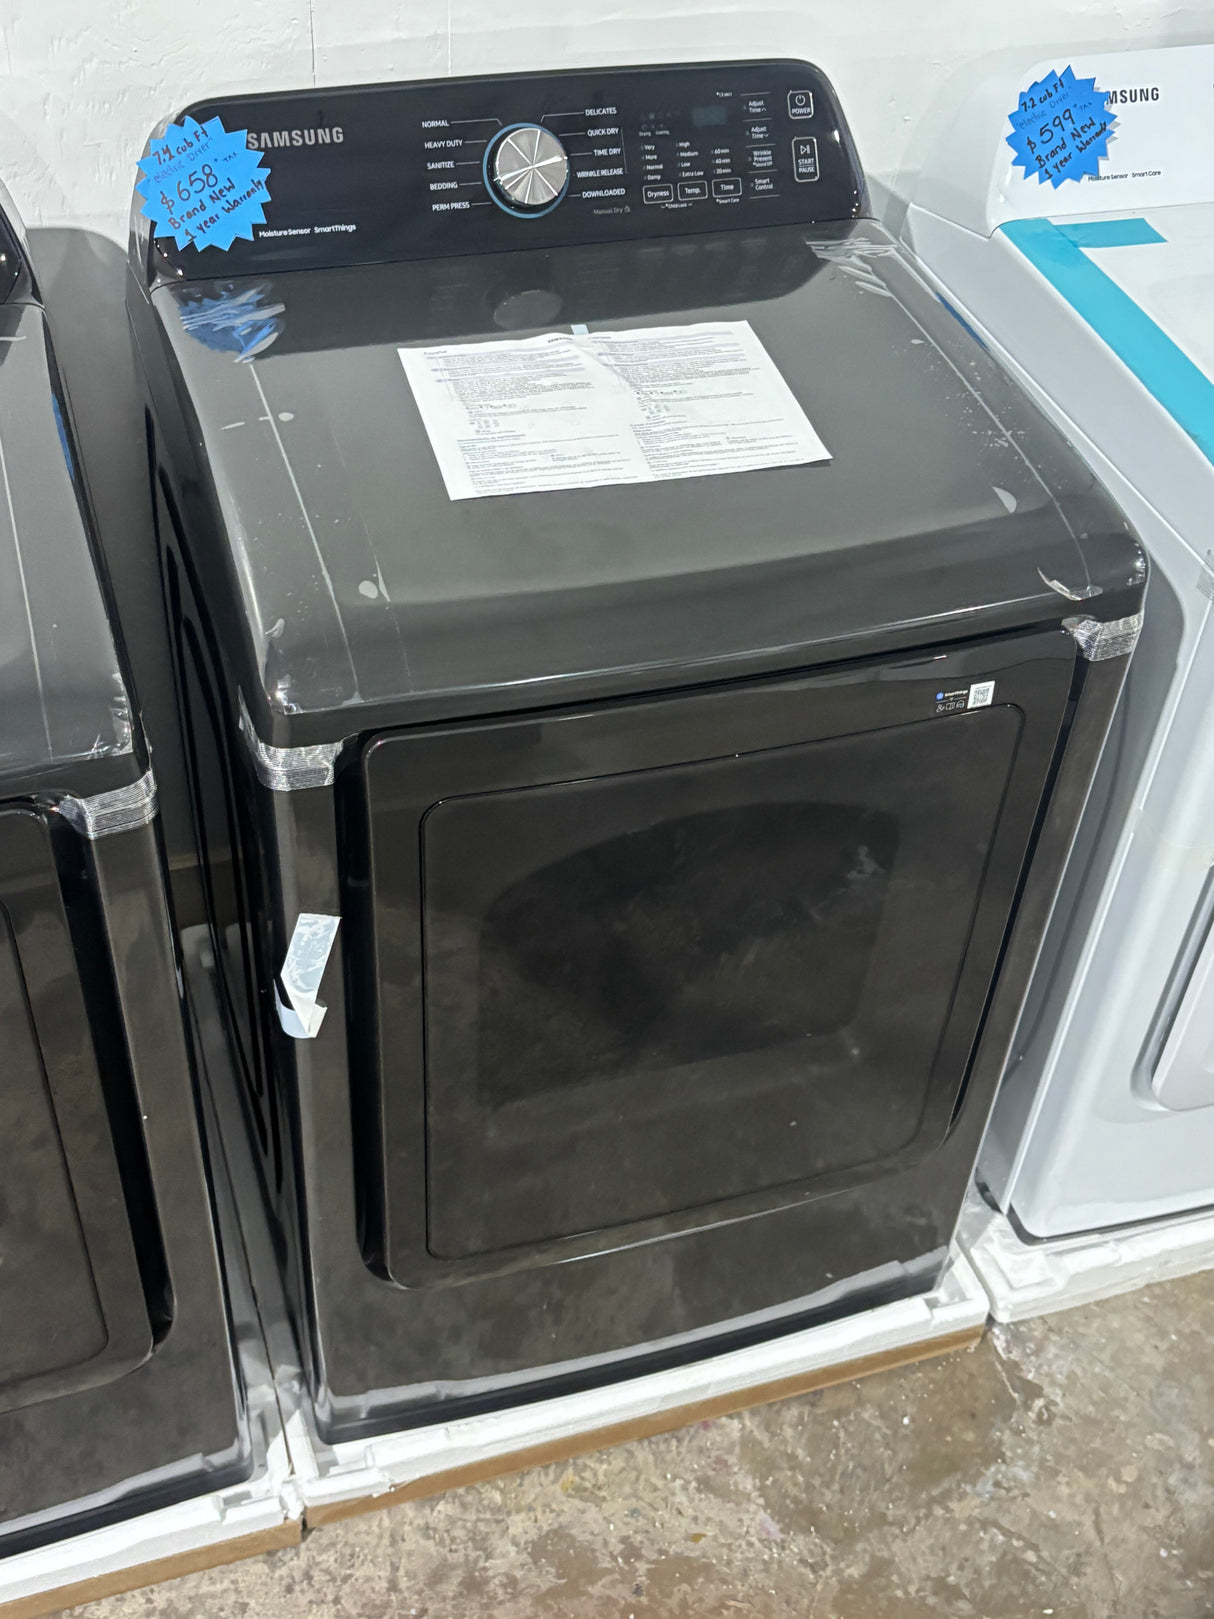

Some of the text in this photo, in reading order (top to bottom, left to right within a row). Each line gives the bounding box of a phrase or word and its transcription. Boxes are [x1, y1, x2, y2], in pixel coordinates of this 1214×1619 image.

[1021, 97, 1037, 112] 7.2
[1039, 89, 1053, 104] cub
[1106, 87, 1160, 105] MSUNG
[585, 107, 617, 116] DELICATES
[422, 120, 449, 128] NORMAL
[587, 128, 606, 137] QUICK
[176, 138, 194, 155] cub
[194, 125, 208, 142] Ft
[247, 127, 344, 149] SAMSUNG
[1035, 117, 1096, 169] Brand New
[427, 161, 455, 170] SANITIZE
[576, 168, 624, 178] WRINKLE RELEASE
[1044, 168, 1053, 180] 1
[430, 182, 458, 190] BEDDING
[582, 188, 625, 198] DOWNLOADED
[647, 190, 669, 198] Dryness
[168, 177, 236, 229] Brand New
[432, 202, 470, 211] PERM PRESS
[185, 228, 197, 242] 1
[222, 179, 264, 213] Warranty
[314, 224, 356, 234] SmartThings
